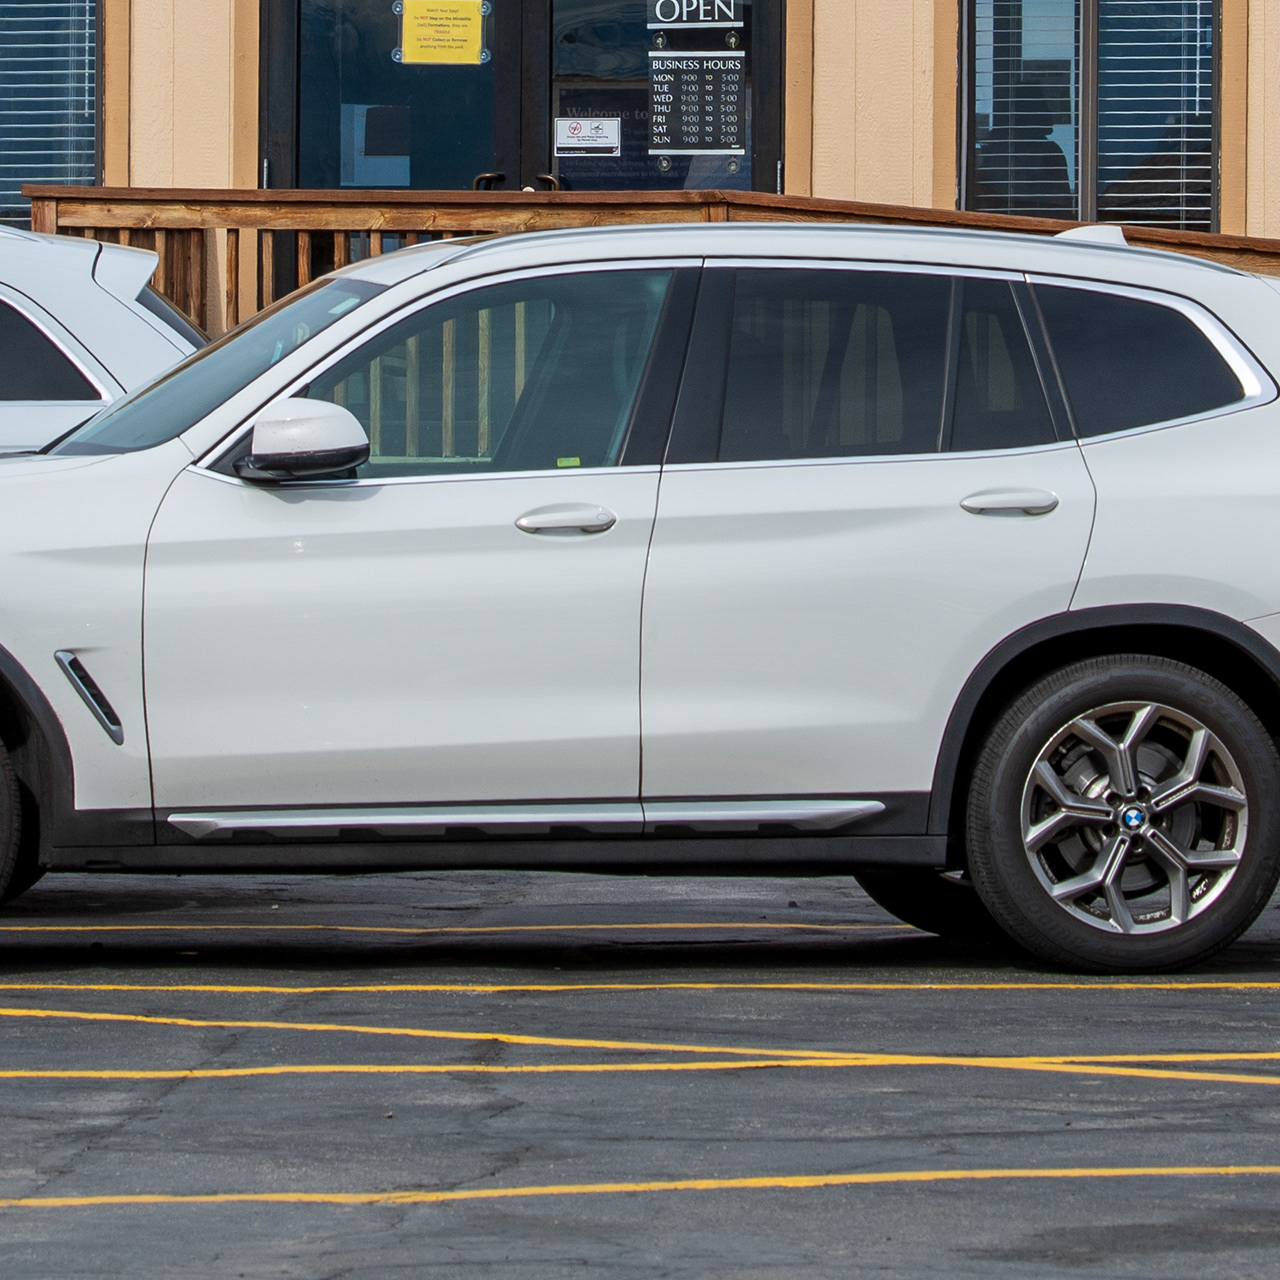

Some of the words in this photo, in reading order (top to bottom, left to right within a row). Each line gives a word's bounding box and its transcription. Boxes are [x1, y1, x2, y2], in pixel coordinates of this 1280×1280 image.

[652, 60, 700, 70] BUSINESS
[703, 60, 741, 70] HOURS
[653, 74, 674, 82] MON
[681, 74, 697, 82] 9:00
[721, 74, 739, 82] 5:00
[653, 84, 669, 92] TUE
[681, 84, 698, 92] 9:00
[721, 84, 738, 92] 5:00
[653, 94, 673, 102] WED
[681, 94, 698, 102] 9:00
[720, 94, 737, 102] 5:00
[566, 107, 630, 119] Welcome
[635, 108, 648, 119] to
[653, 105, 671, 113] THU
[681, 105, 699, 113] 9:00
[720, 105, 736, 113] 5:00
[653, 115, 666, 123] FRI
[682, 115, 699, 123] 9:00
[720, 115, 737, 123] 5:00
[653, 125, 667, 133] SAT
[682, 125, 699, 133] 9:00
[721, 125, 738, 133] 5:00
